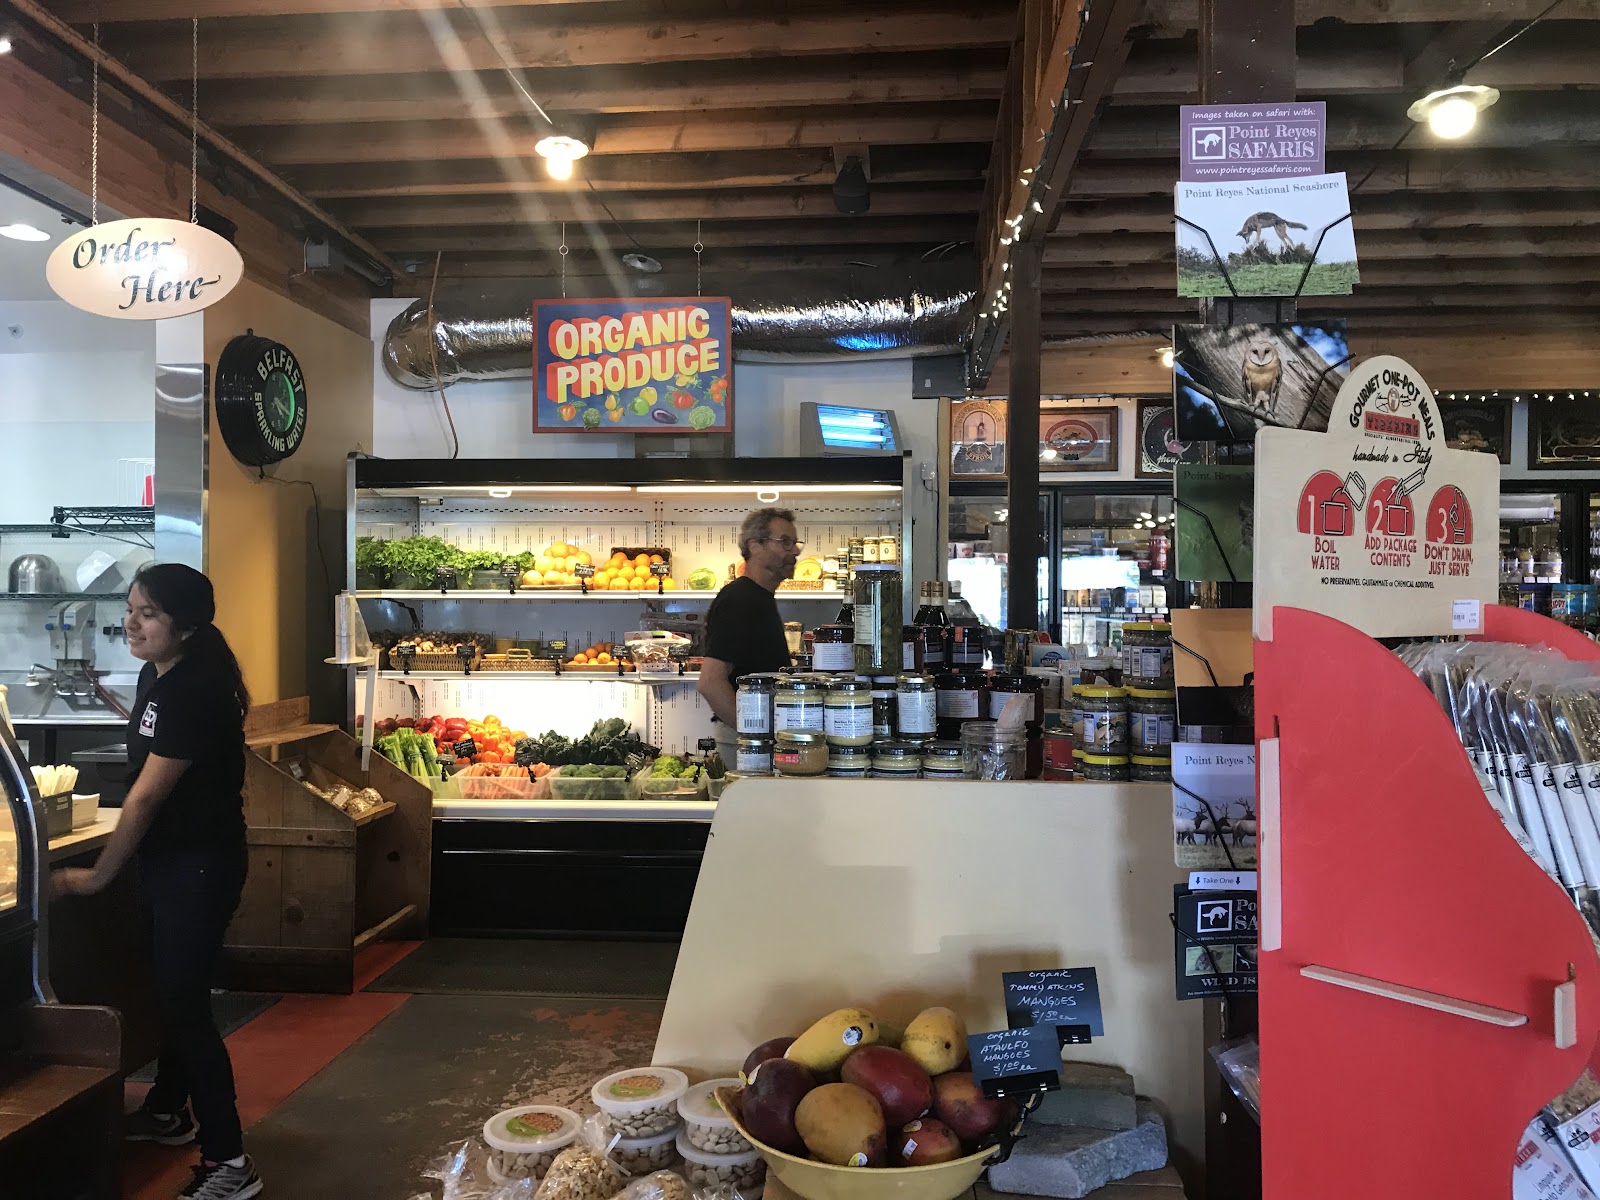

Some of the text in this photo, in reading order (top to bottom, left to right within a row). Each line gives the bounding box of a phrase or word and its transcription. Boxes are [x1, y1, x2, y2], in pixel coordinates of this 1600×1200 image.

[1192, 111, 1222, 121] Images
[1224, 109, 1249, 118] taken
[1266, 108, 1291, 118] safari
[1293, 108, 1316, 116] with:
[1229, 124, 1317, 140] Point Reyes
[1228, 141, 1315, 160] SAFARIS
[1195, 165, 1312, 176] www.pointreyessafaris.com
[1184, 181, 1339, 199] Point Reyes National Seashore
[72, 227, 176, 269] Order
[118, 267, 221, 309] Here
[551, 305, 710, 360] ORGANIC
[257, 348, 304, 393] BELFAST
[550, 338, 720, 404] PRODUCE
[1350, 374, 1380, 428] GOURMET
[1382, 369, 1420, 401] ONE-POT
[1418, 397, 1435, 440] MEALS
[254, 392, 305, 452] SPARKLING WATER
[1352, 444, 1389, 463] handmade
[1403, 444, 1432, 465] Italy
[1183, 470, 1209, 480] Point
[1308, 494, 1314, 534] 1
[1372, 500, 1383, 534] 2
[1436, 508, 1448, 543] 3
[1365, 535, 1416, 553] ADD PACKAGE
[1370, 552, 1410, 567] CONTENTS
[1424, 543, 1474, 564] DON'T DRAIN,
[1312, 555, 1340, 571] WATER
[1428, 562, 1469, 576] JUST SERVE
[1185, 756, 1212, 764] Point
[1216, 756, 1244, 767] Reyes
[1029, 970, 1072, 983] organic
[1010, 983, 1084, 996] TOMMY ATKINS
[1018, 996, 1076, 1006] MANGOES
[987, 1028, 1030, 1045] organic
[981, 1041, 1028, 1054] ATAULFO
[984, 1050, 1030, 1062] MANGOES
